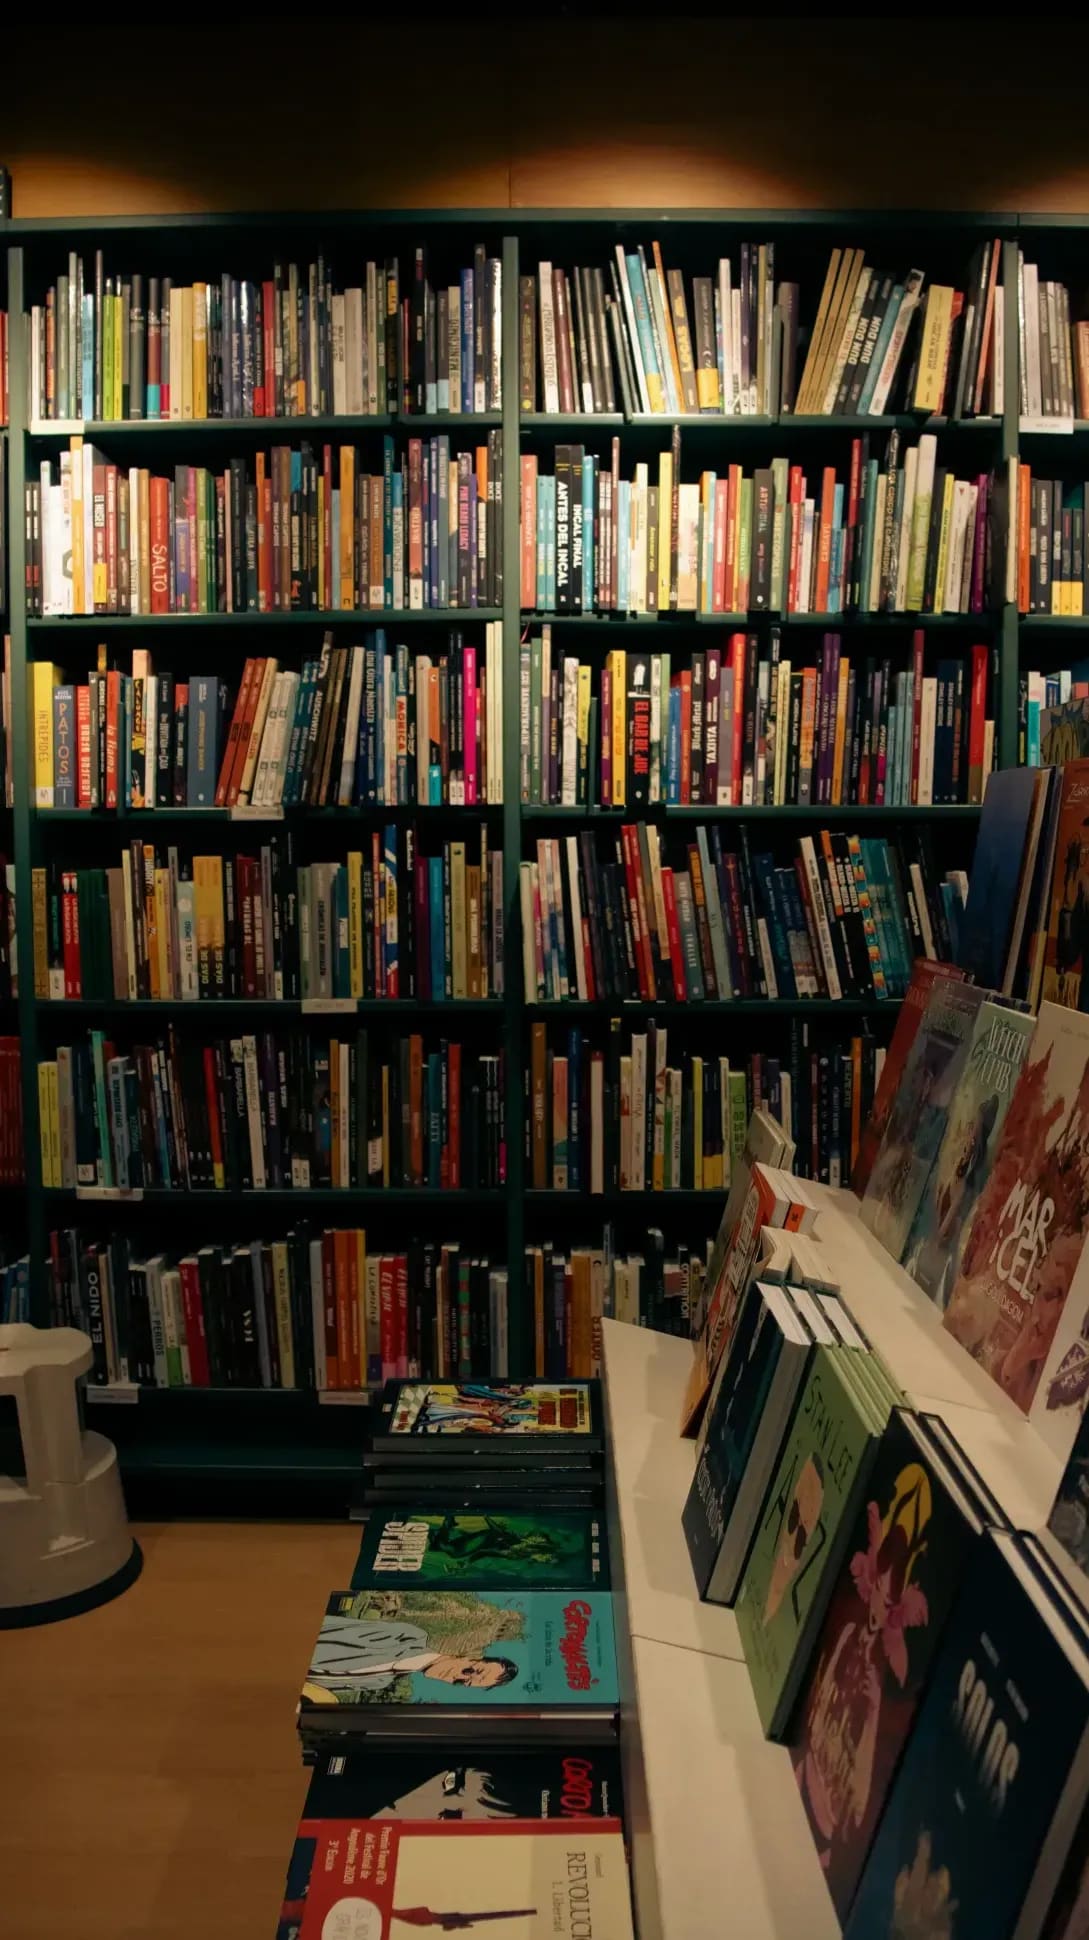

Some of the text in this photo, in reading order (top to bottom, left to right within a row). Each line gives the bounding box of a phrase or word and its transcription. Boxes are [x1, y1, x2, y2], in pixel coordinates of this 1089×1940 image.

[448, 319, 460, 371] MANICOMIO
[677, 326, 693, 372] LOCAS
[847, 317, 869, 365] DUM DUM
[860, 315, 882, 364] DUM DUM
[758, 487, 768, 533] ARTIFICIAL
[557, 482, 568, 587] ANTES DEL INCAL
[573, 504, 582, 569] INCAL FINAL
[152, 544, 168, 592] SALTO
[57, 702, 70, 774] PATOS
[309, 691, 323, 742] AUSCHWITZ
[634, 701, 649, 775] EL BAR DE JOE
[706, 726, 717, 764] TAXISTA
[998, 1178, 1056, 1259] MAR
[87, 1271, 103, 1344] EL NIDO
[153, 1319, 164, 1356] PERROS
[361, 1844, 375, 1869] Festival
[364, 1832, 375, 1844] del
[379, 1826, 393, 1850] Premio
[342, 1865, 356, 1885] 2020
[566, 1852, 592, 1940] REVOLUCI
[551, 1892, 564, 1932] Libertad
